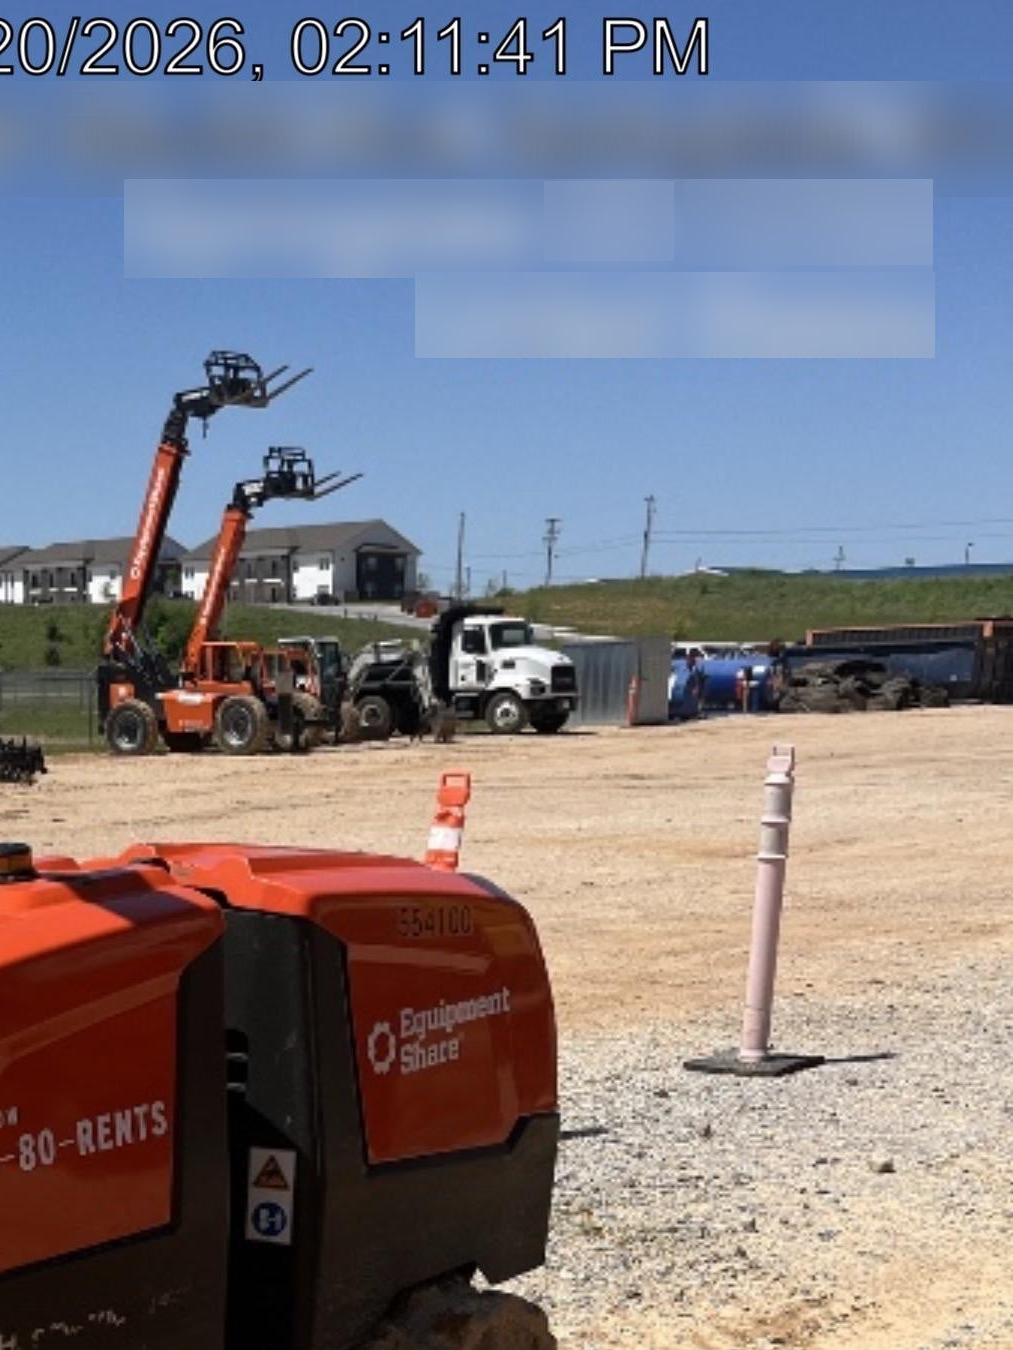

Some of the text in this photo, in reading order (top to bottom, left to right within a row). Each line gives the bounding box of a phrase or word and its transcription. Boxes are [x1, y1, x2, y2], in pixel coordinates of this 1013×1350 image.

[397, 904, 473, 937] 554100
[400, 986, 511, 1040] Equipment
[400, 1038, 460, 1075] Share
